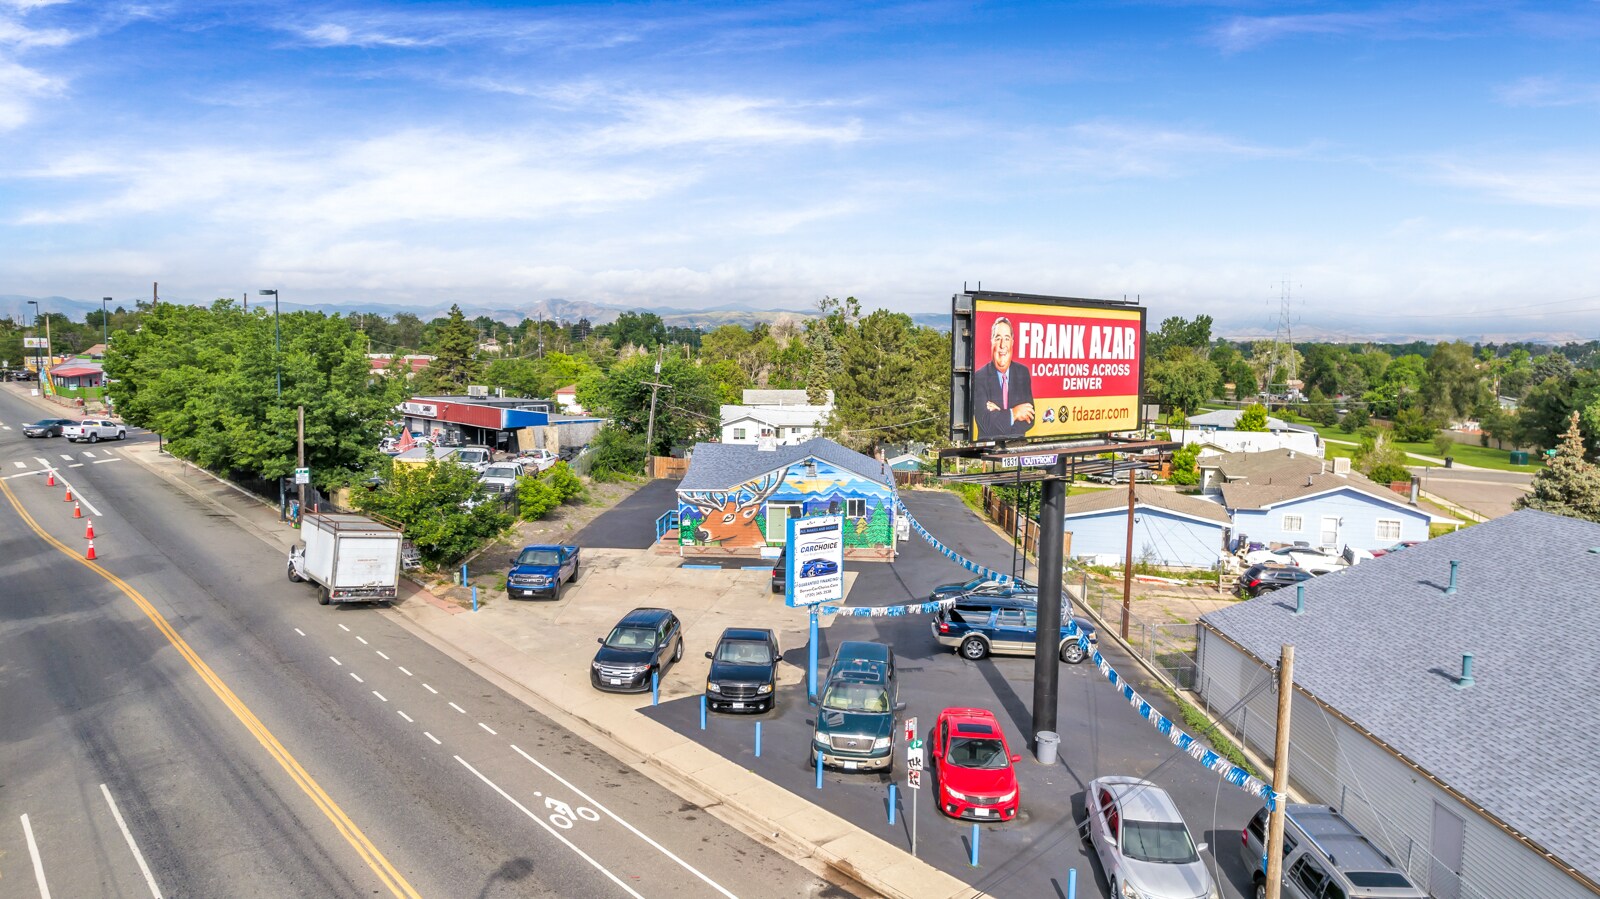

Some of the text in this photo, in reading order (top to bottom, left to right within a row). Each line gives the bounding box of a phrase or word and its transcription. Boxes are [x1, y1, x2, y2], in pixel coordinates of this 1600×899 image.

[1018, 322, 1136, 360] FRANK AZAR
[1031, 363, 1130, 377] LOCATIONS ACROSS
[1063, 377, 1102, 391] DENVER
[1072, 406, 1129, 422] fdazar.com
[1003, 457, 1018, 467] 1831
[1023, 455, 1055, 466] OUTFRONT
[800, 541, 838, 553] CARCHOICE
